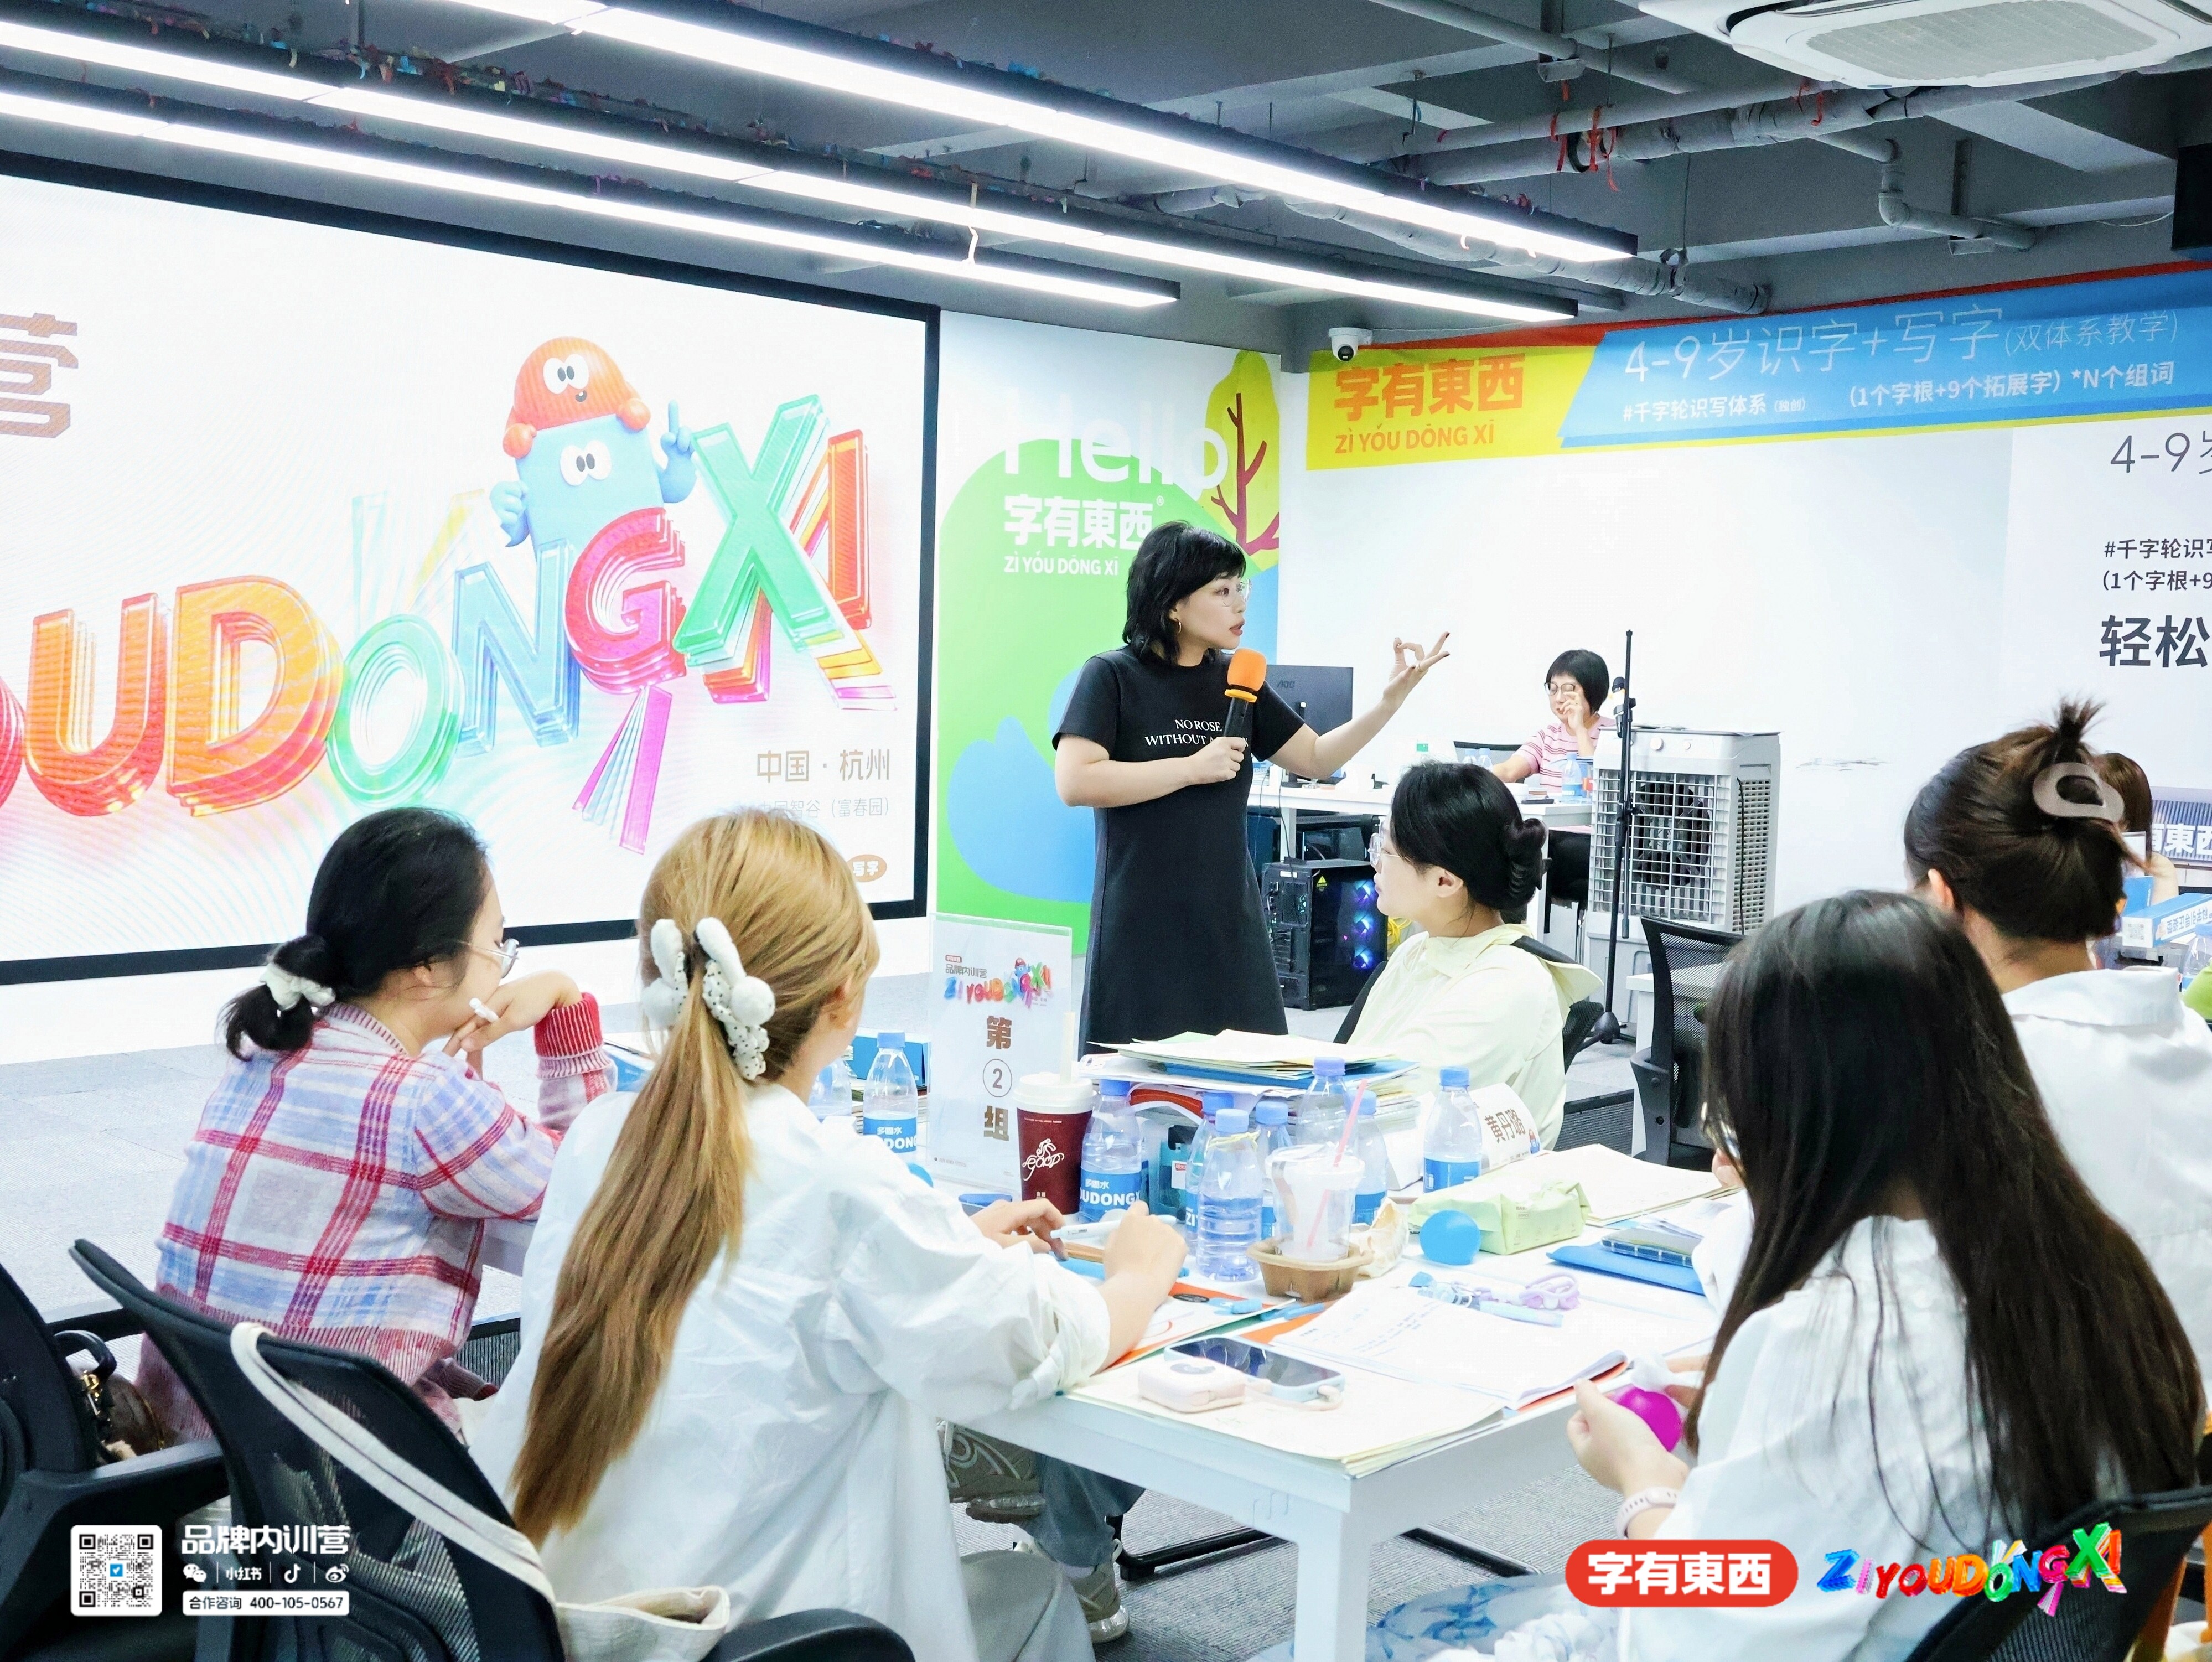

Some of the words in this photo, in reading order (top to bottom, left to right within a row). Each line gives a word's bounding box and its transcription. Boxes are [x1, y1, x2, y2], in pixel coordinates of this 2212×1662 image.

[1334, 353, 1525, 421] 字有東西
[1004, 387, 1229, 489] Hello
[1004, 494, 1153, 550] 字有東西
[2104, 538, 2212, 560] #千字轮识
[0, 394, 872, 817] UDONGXI
[2099, 615, 2211, 668] 轻松
[1144, 734, 1206, 746] WITHOUT
[1174, 719, 1193, 729] NO
[1194, 721, 1222, 732] ROSE
[852, 860, 879, 877] 写字
